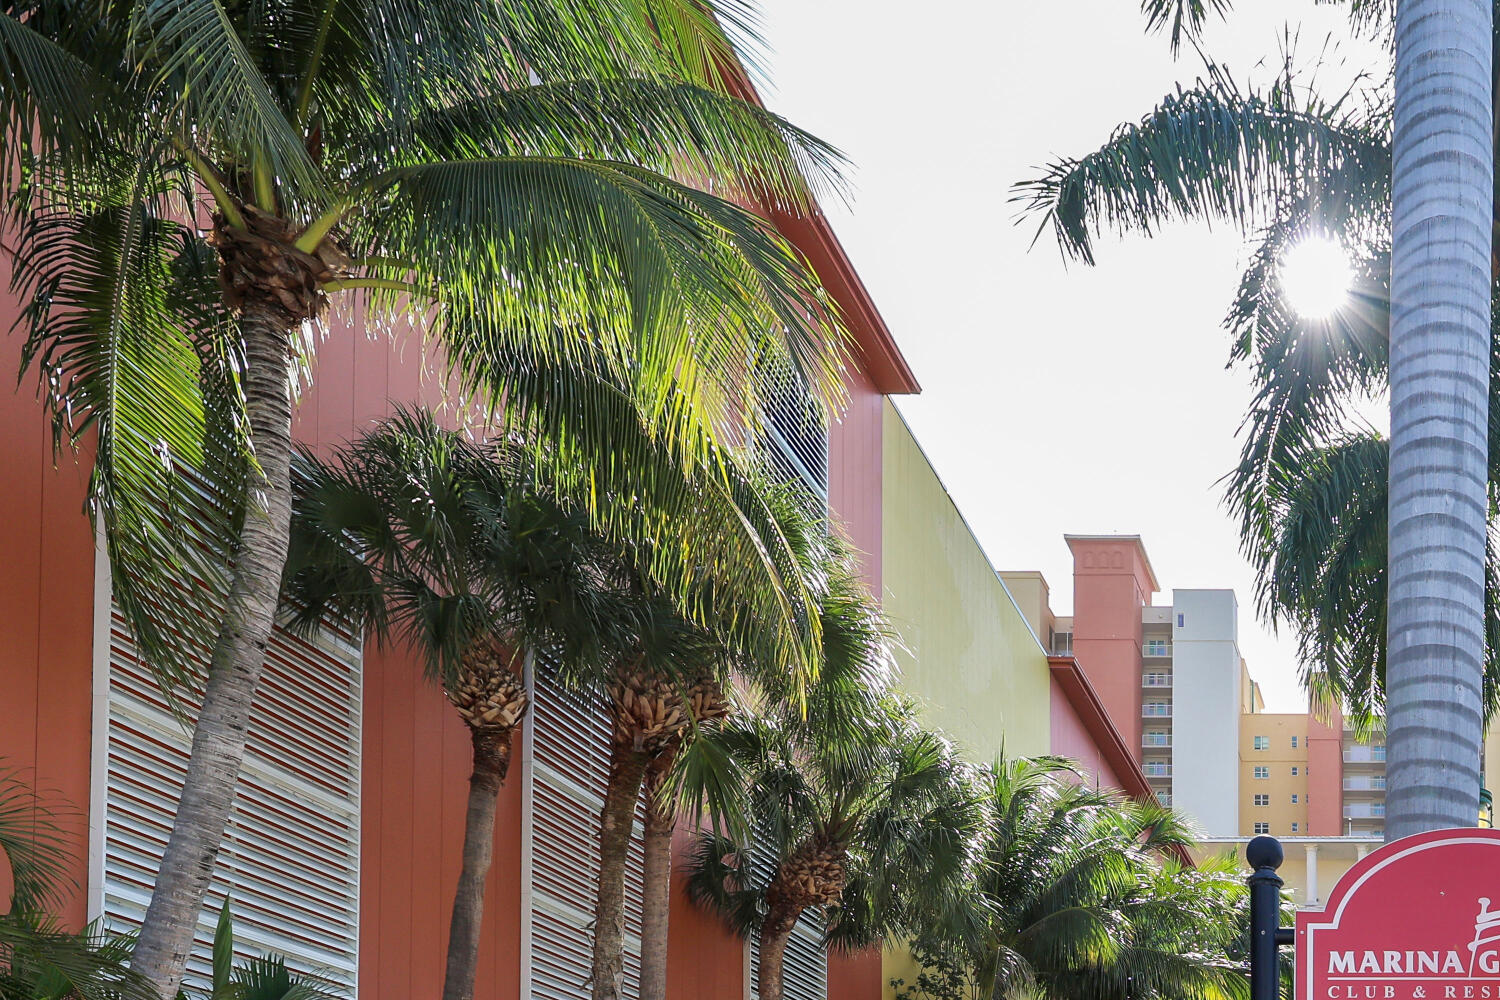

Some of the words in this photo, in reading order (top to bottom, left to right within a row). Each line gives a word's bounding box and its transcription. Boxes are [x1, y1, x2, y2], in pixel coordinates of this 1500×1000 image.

[1327, 950, 1466, 975] MARINA
[1327, 985, 1396, 1000] CLUB
[1411, 985, 1427, 1000] &
